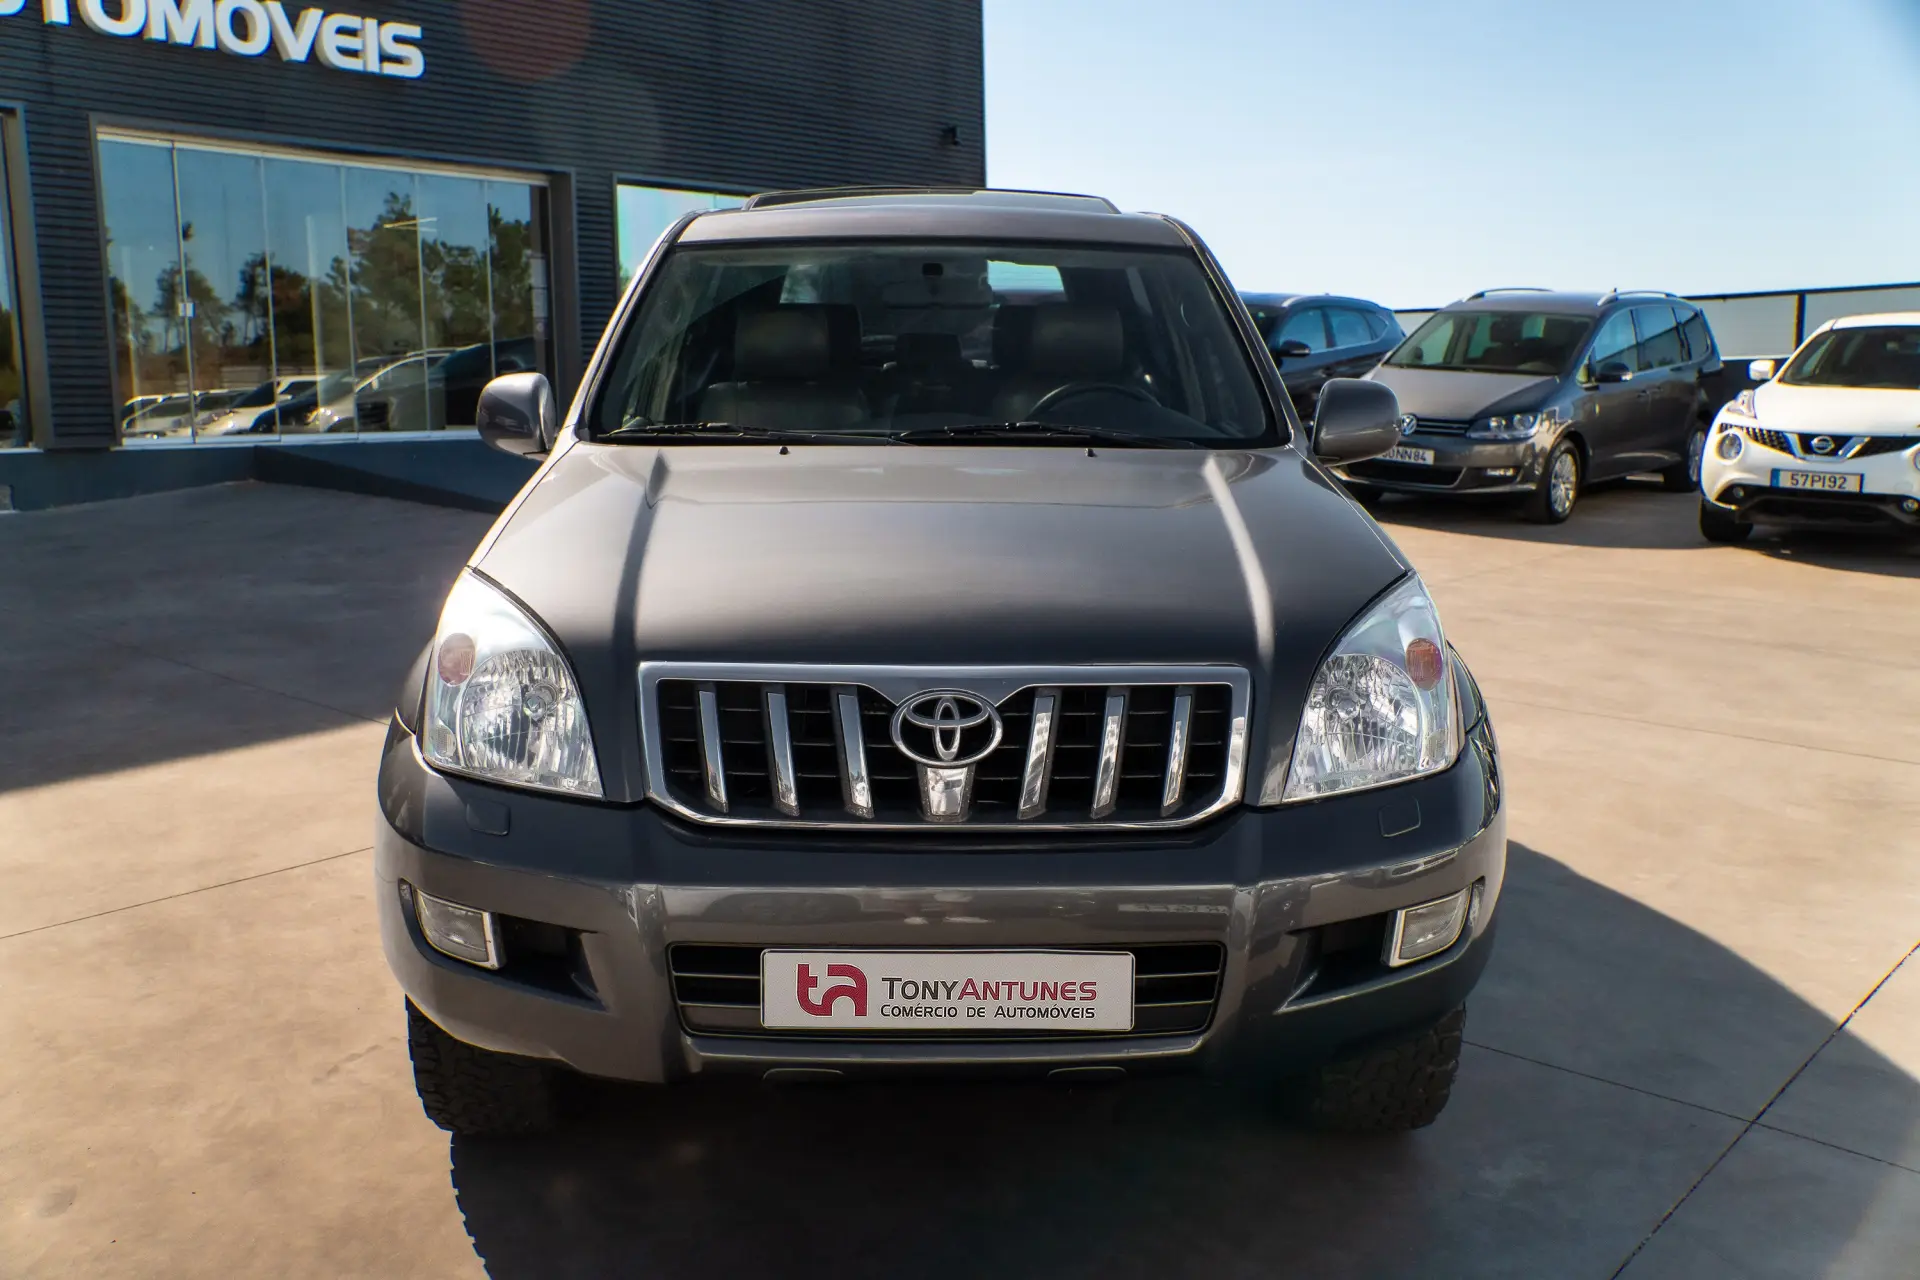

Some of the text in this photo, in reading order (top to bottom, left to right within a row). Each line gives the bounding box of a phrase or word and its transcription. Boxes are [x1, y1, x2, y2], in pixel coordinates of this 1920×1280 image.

[0, 0, 424, 79] OMOVEIS
[1790, 473, 1847, 490] 57PI92
[880, 1003, 1095, 1019] COMÉRCIO DE AUTOMÓVEIS
